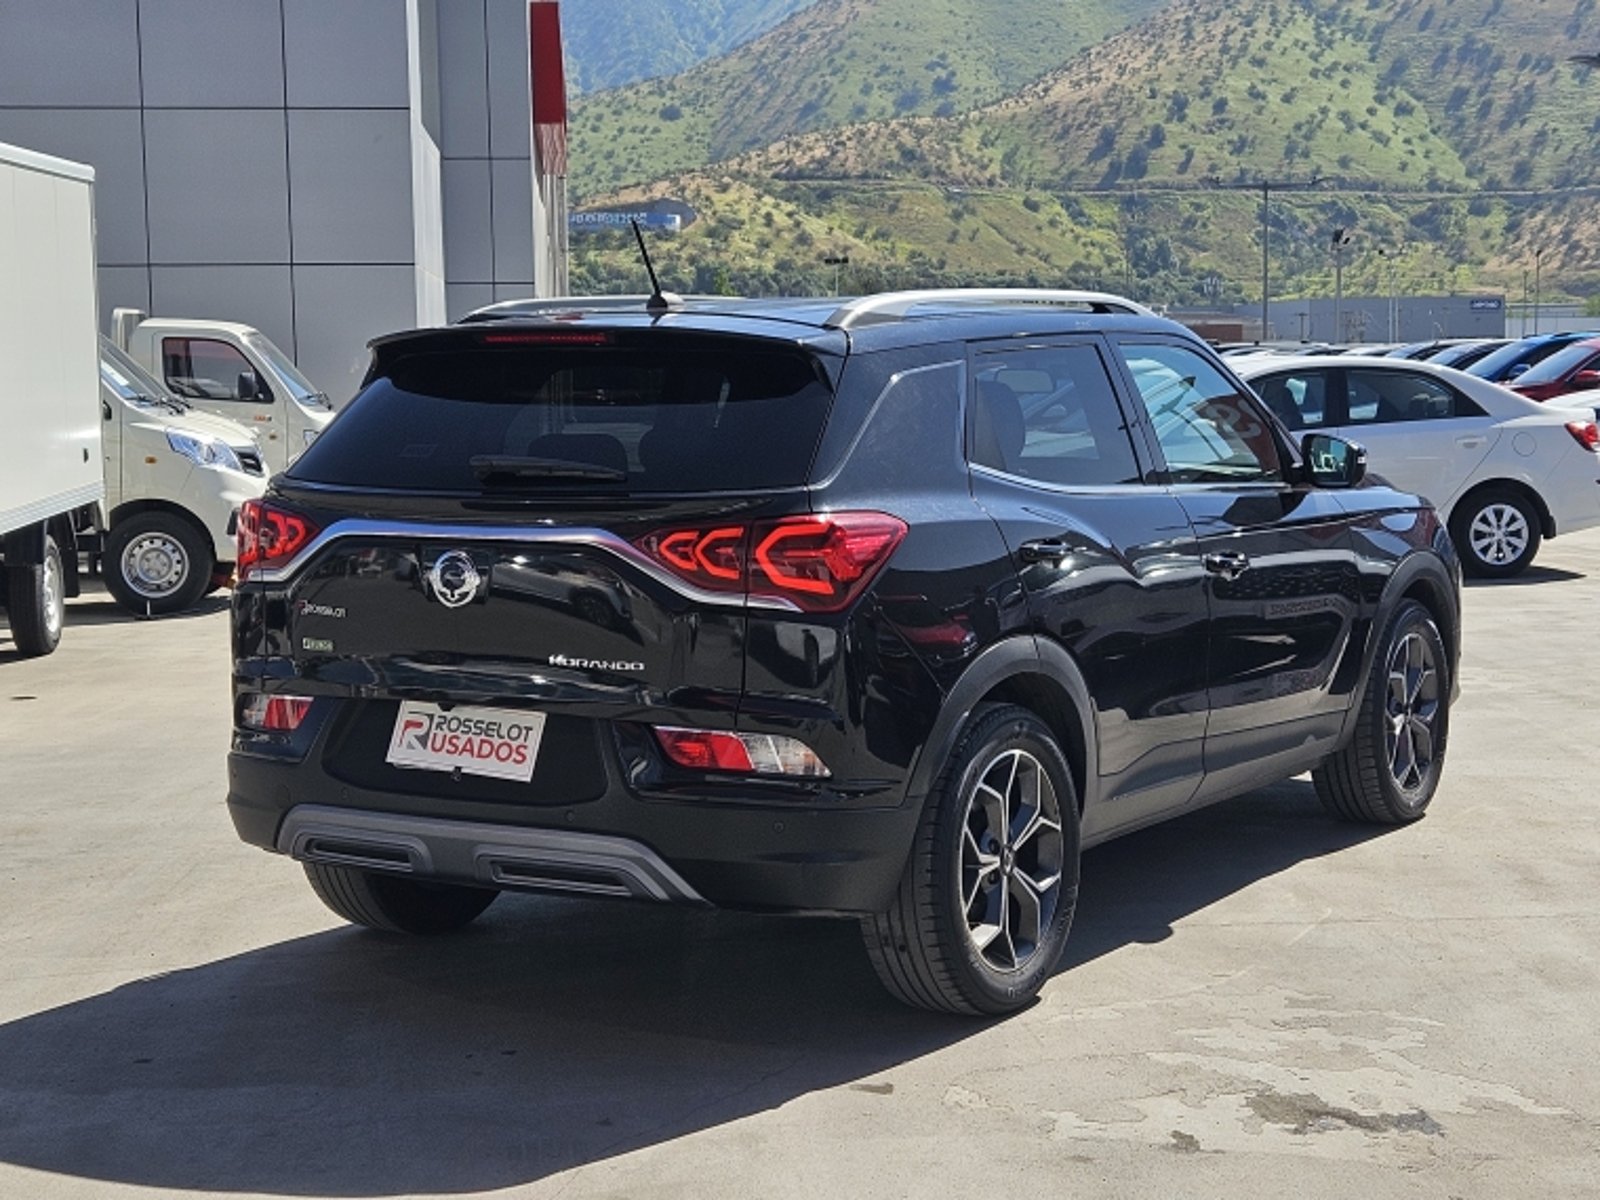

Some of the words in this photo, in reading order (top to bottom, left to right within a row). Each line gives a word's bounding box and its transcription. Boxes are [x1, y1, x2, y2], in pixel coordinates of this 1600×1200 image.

[548, 653, 645, 671] KORANDO
[434, 714, 534, 743] ROSSELOT
[430, 733, 528, 765] USADOS
